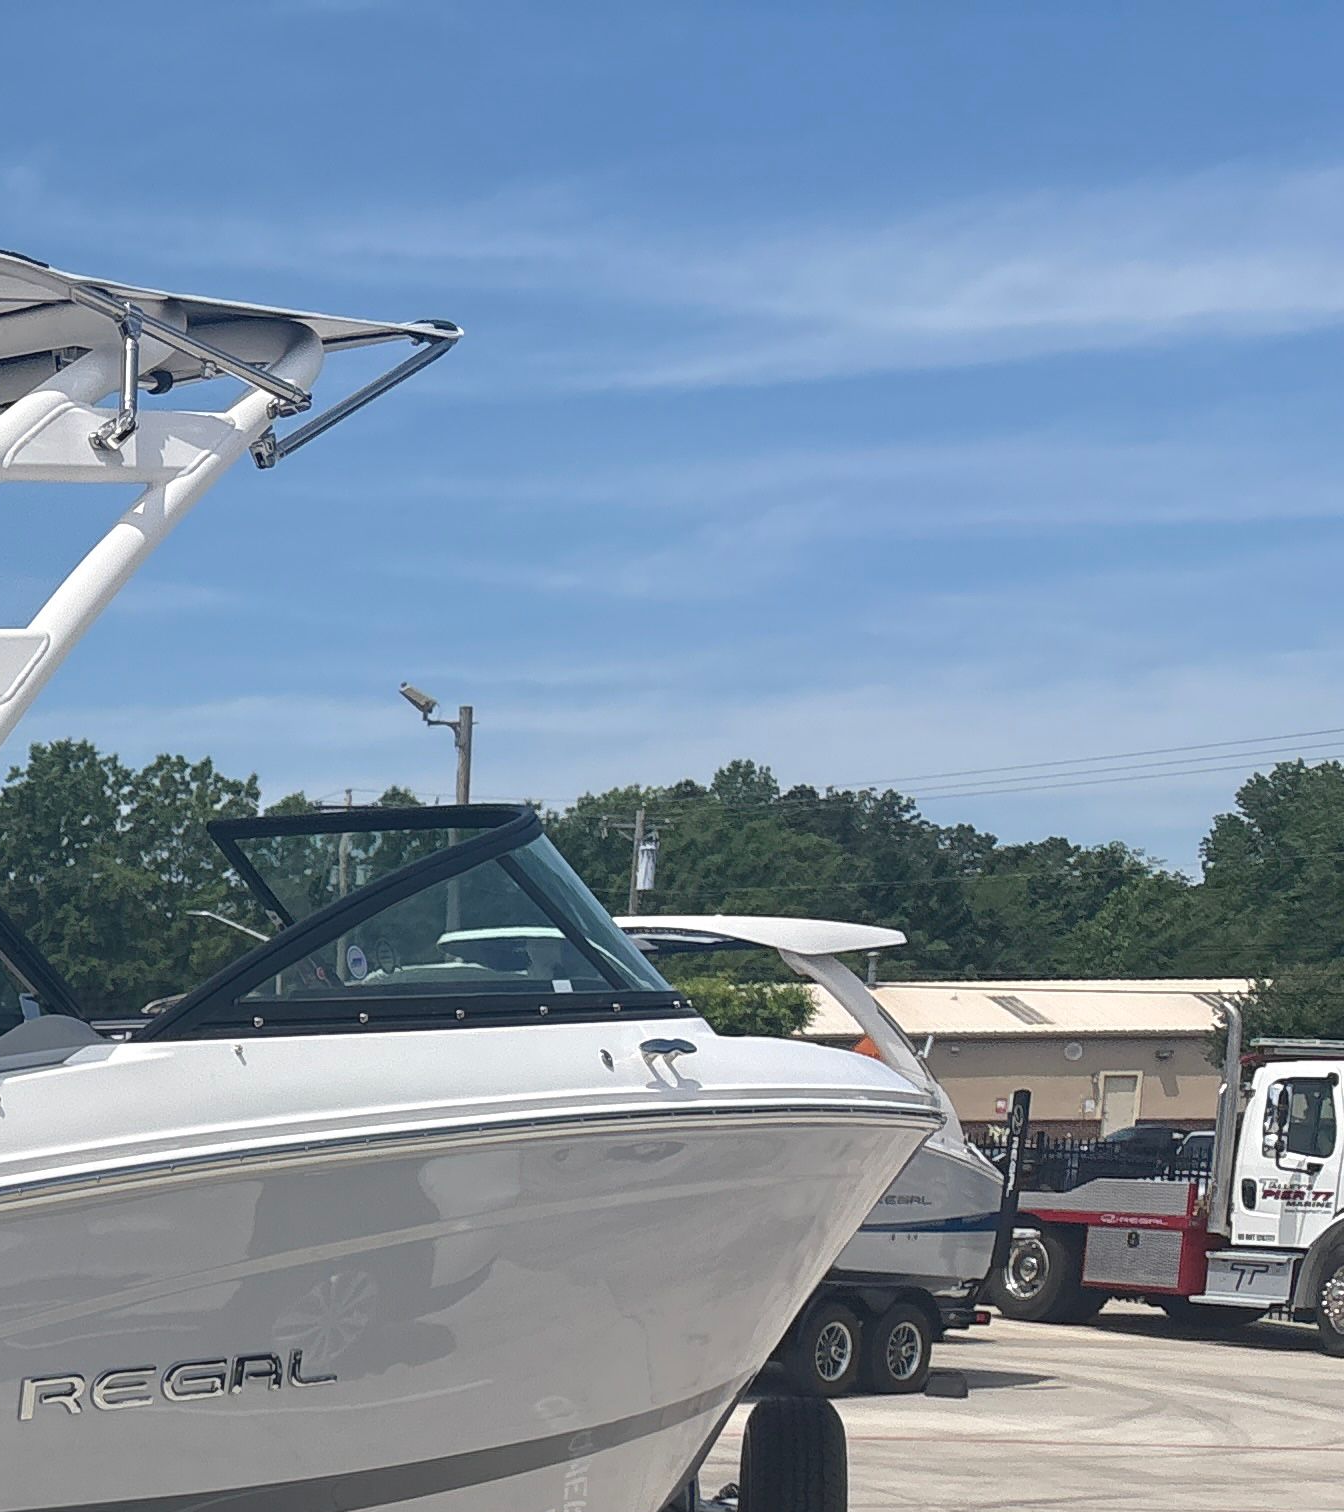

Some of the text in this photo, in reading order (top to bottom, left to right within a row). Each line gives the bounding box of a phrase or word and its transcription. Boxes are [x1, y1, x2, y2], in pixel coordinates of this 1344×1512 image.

[1261, 1189, 1335, 1202] PIER 77
[17, 1347, 338, 1421] REGAL
